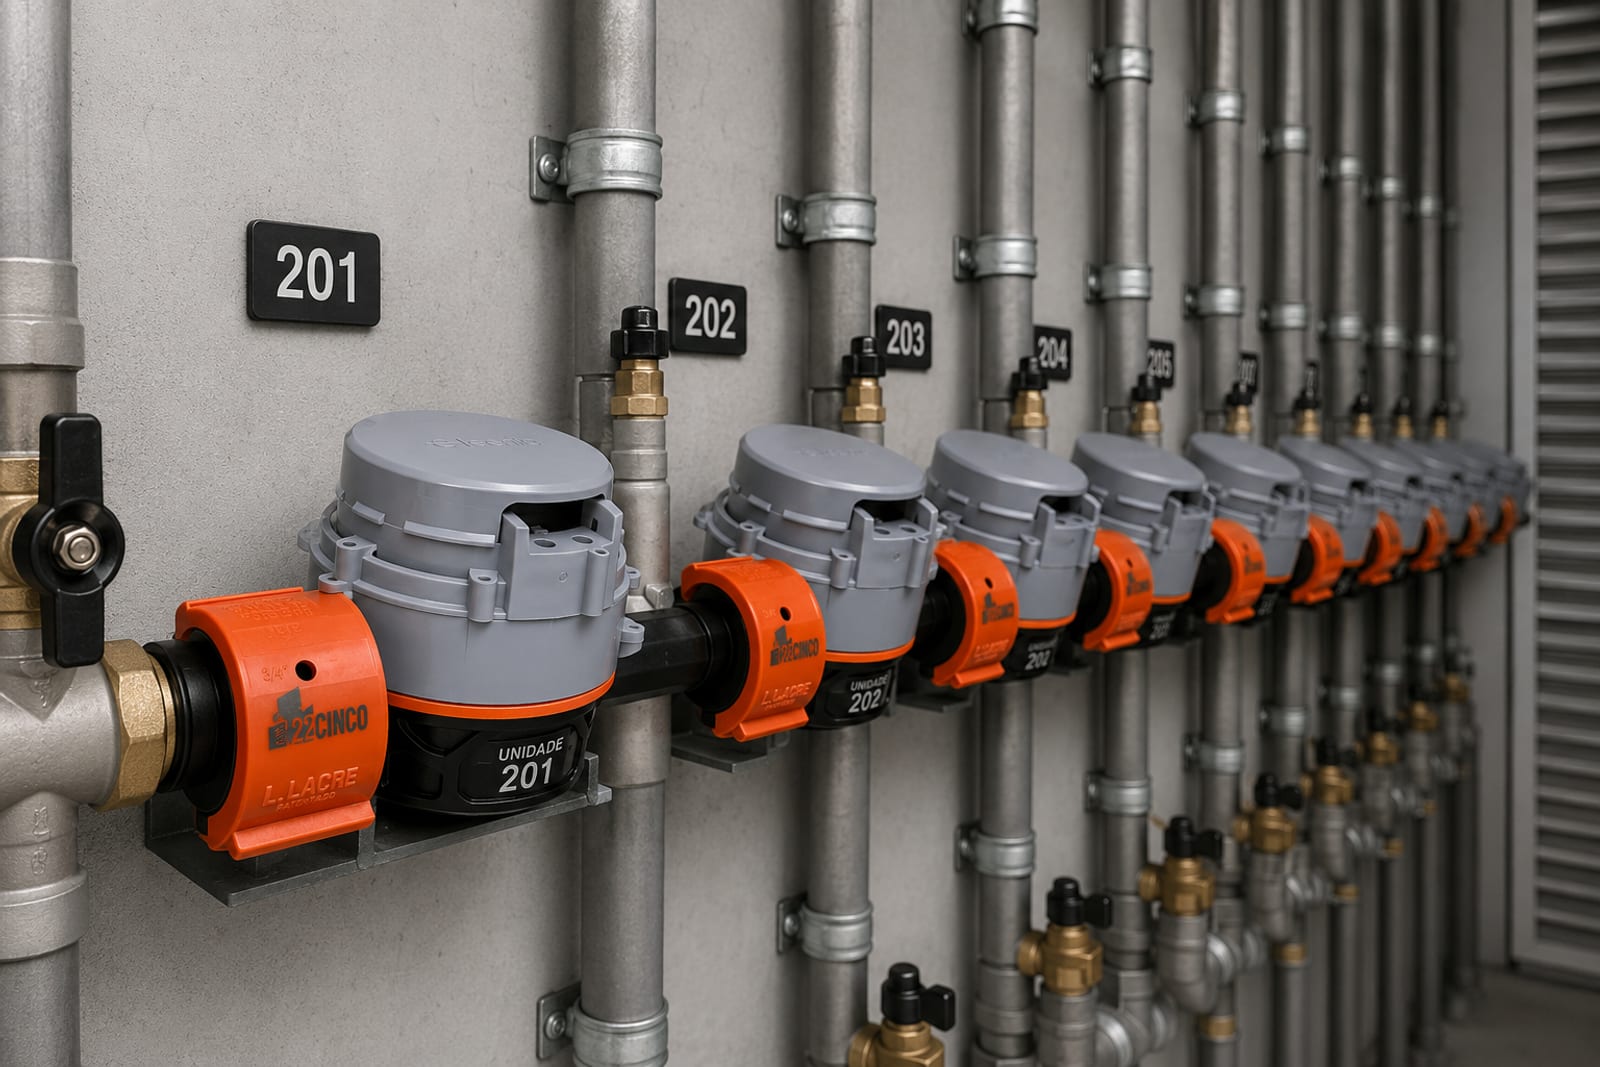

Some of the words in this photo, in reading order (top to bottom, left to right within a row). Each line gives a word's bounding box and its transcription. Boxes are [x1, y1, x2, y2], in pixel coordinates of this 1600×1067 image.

[276, 244, 356, 303] 201
[685, 294, 736, 339] 202
[886, 318, 925, 357] 203
[1037, 335, 1068, 370] 204
[848, 688, 882, 714] 202
[498, 736, 564, 762] UNIDADE
[286, 766, 360, 801] LACRE
[498, 756, 553, 793] 201
